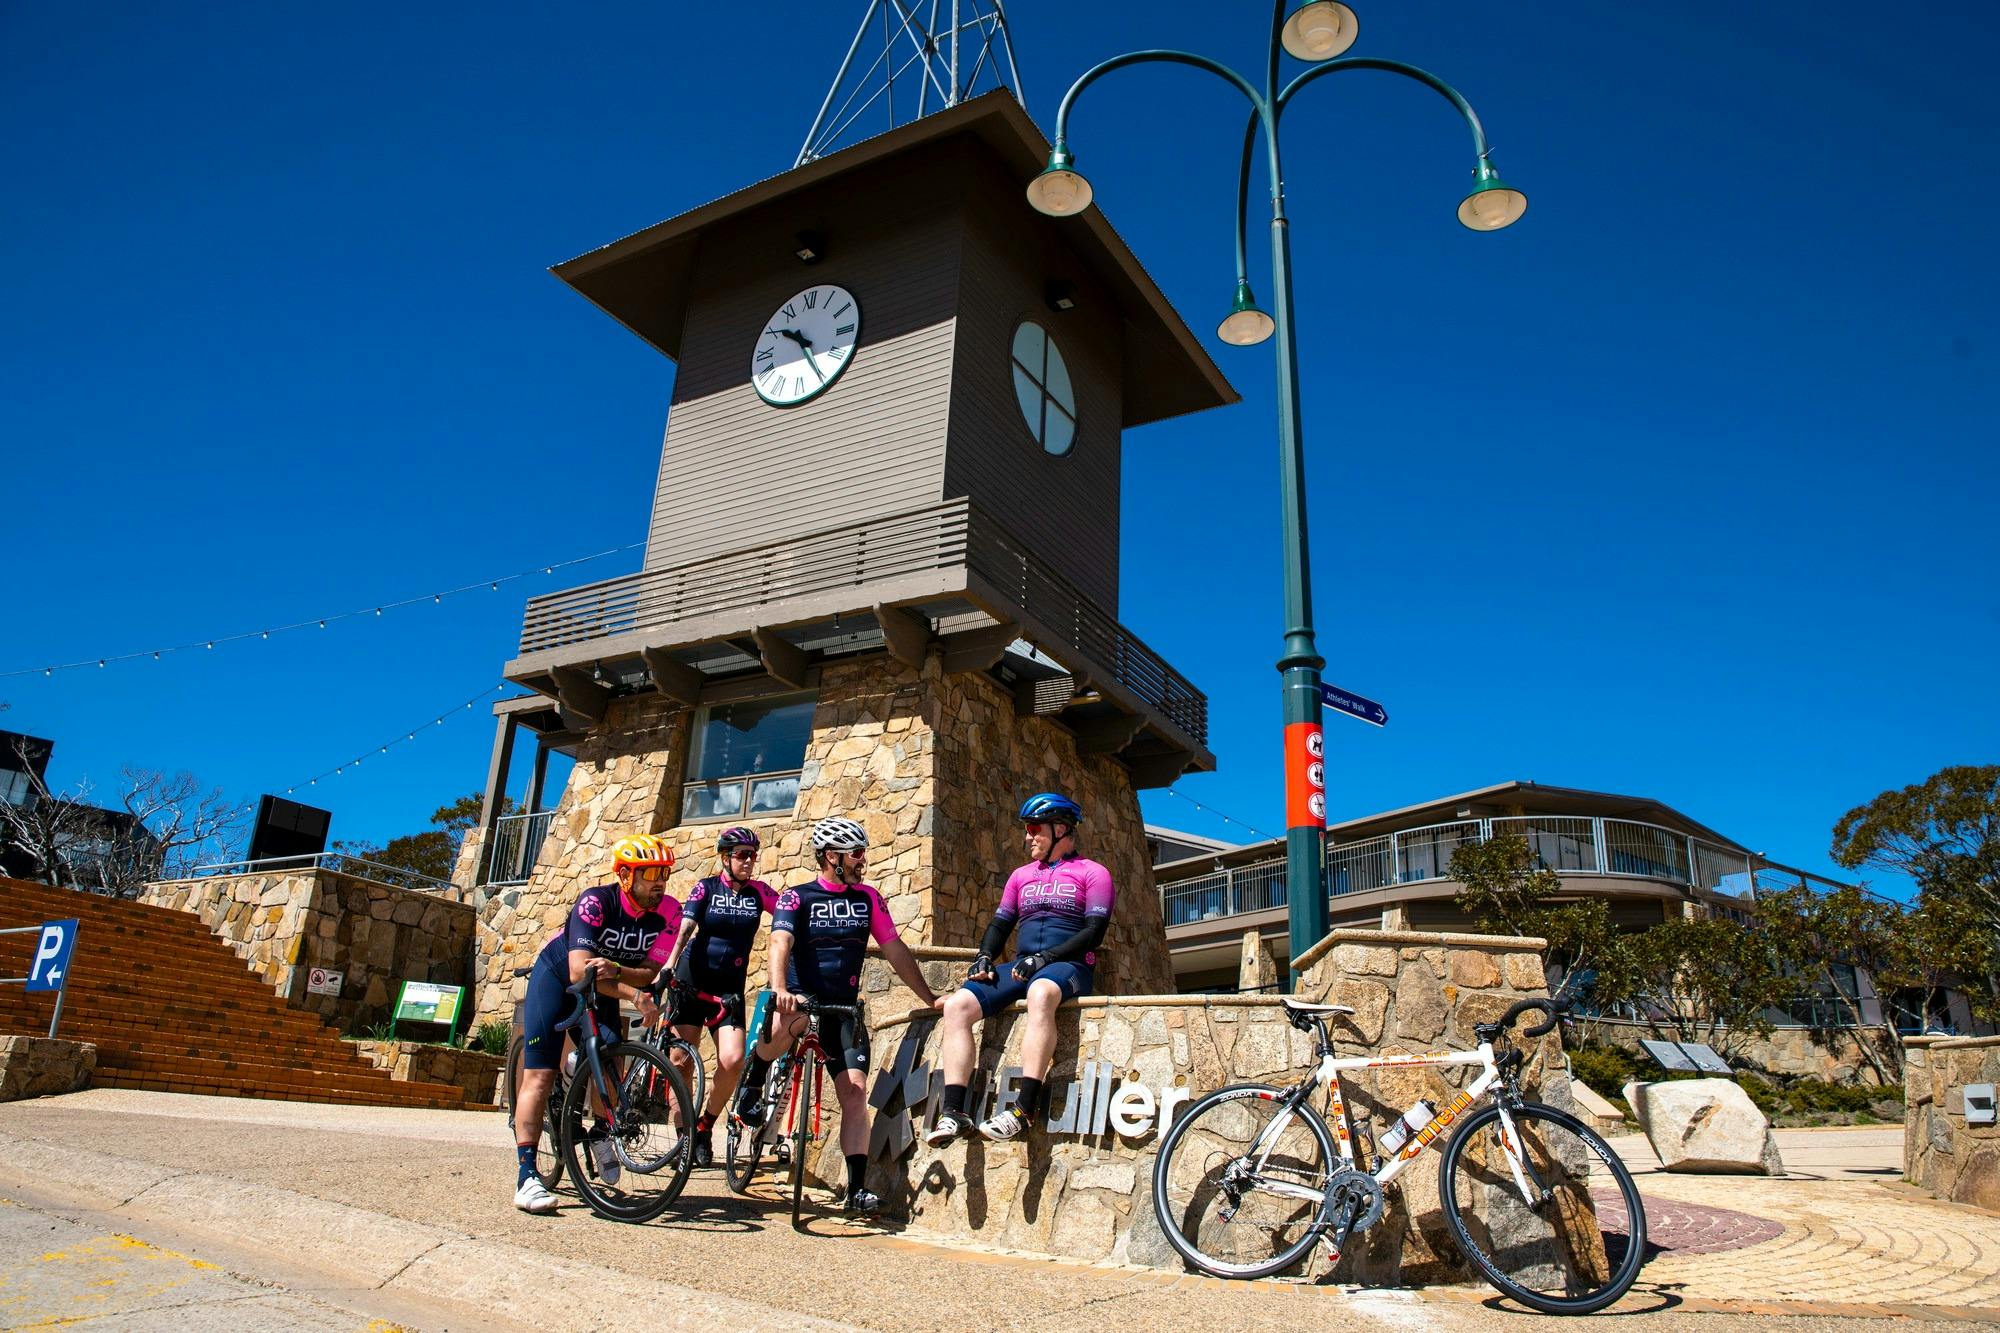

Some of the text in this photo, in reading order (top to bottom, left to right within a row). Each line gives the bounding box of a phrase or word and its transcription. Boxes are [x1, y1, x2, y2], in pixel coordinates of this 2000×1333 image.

[802, 290, 818, 312] XII
[781, 303, 797, 323] XI
[836, 323, 855, 336] III
[756, 346, 775, 361] IX
[1326, 692, 1366, 712] Athletes' Walk
[709, 907, 758, 917] HOLIDAYS
[809, 919, 869, 928] HOLIDAYS
[31, 926, 64, 981] P
[596, 946, 645, 960] HOLIDA
[1219, 1091, 1253, 1103] ZONDA
[1329, 1079, 1349, 1141] Estrada
[1579, 1131, 1612, 1165] ZONDA
